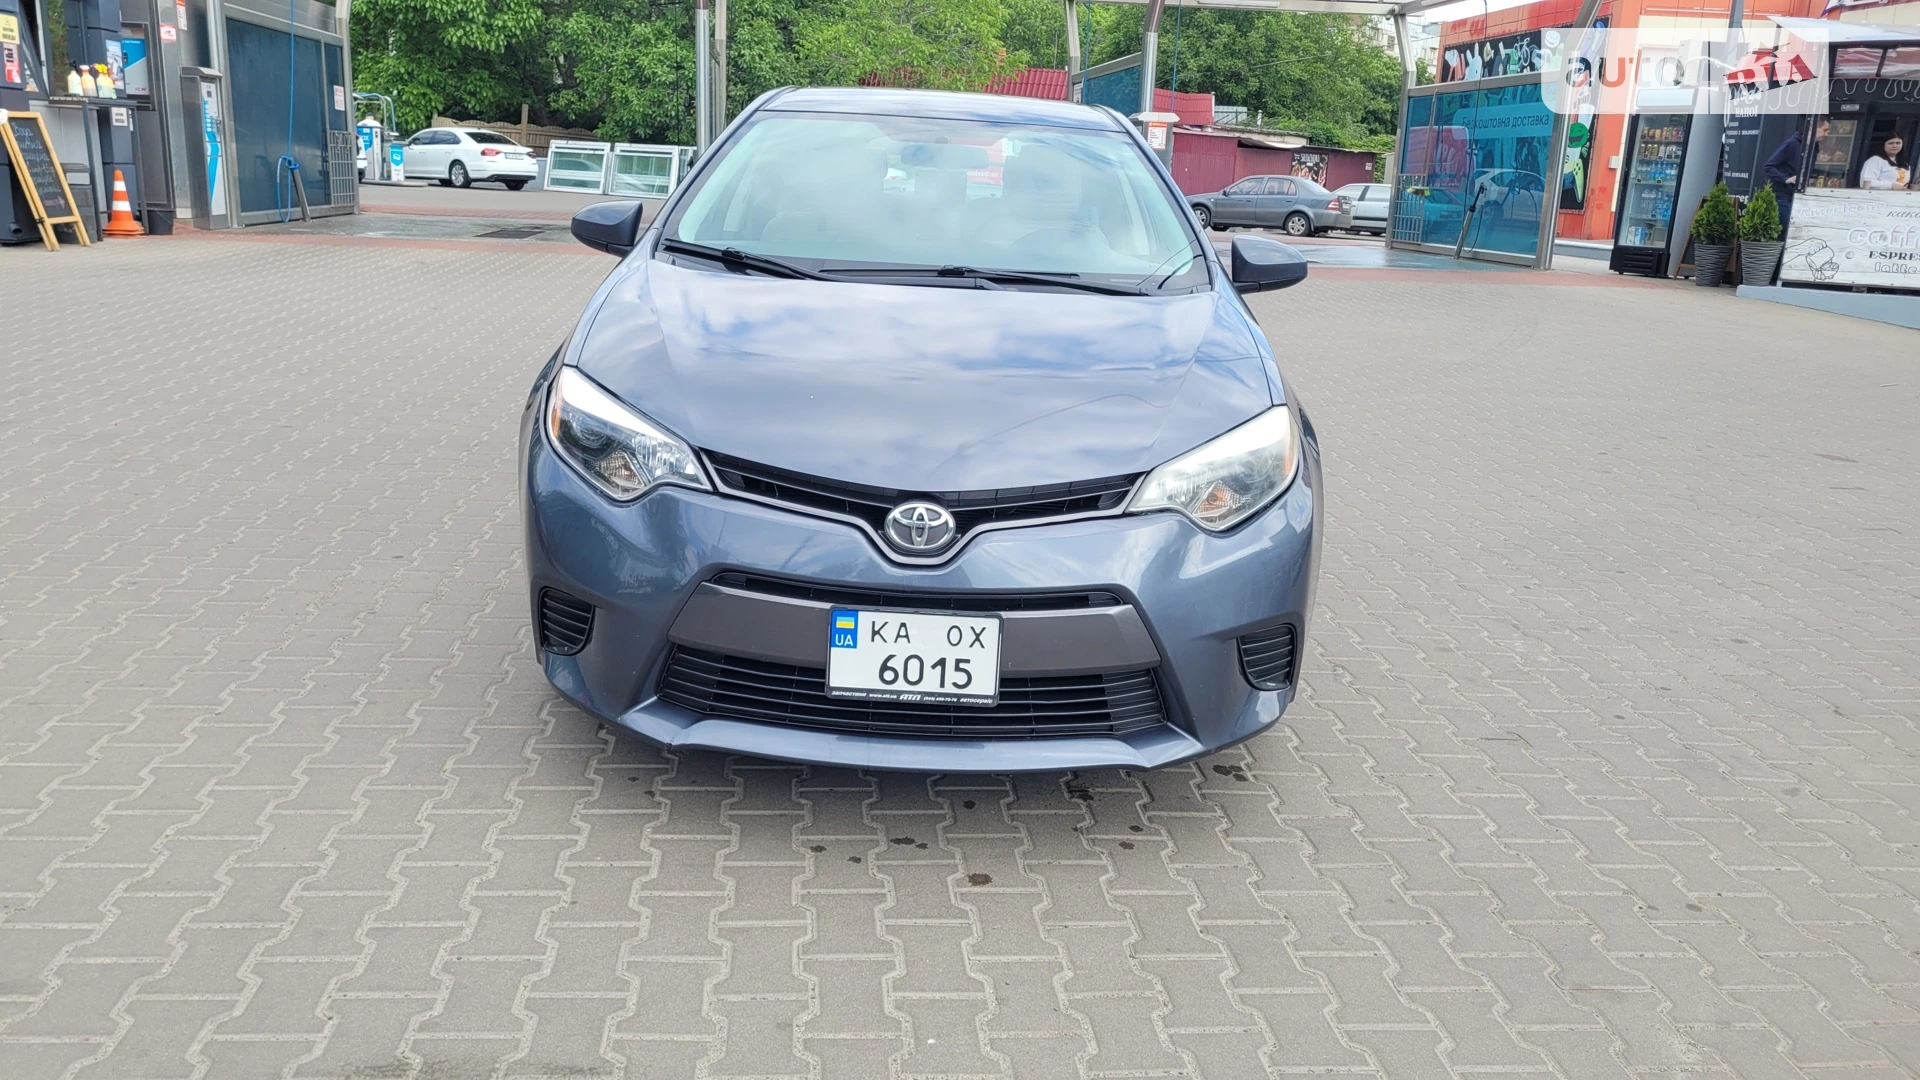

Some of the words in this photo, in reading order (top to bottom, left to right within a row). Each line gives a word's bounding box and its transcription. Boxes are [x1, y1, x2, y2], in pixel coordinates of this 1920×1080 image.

[1735, 105, 1759, 118] НАПОЇ
[1512, 114, 1550, 128] доставка
[1798, 202, 1887, 218] Americano
[1868, 250, 1920, 262] ESPRE
[1874, 261, 1918, 274] latte
[835, 634, 854, 647] UA
[871, 621, 911, 644] KA
[947, 625, 987, 649] OX
[878, 653, 973, 690] 6015
[960, 697, 993, 705] автосервіс
